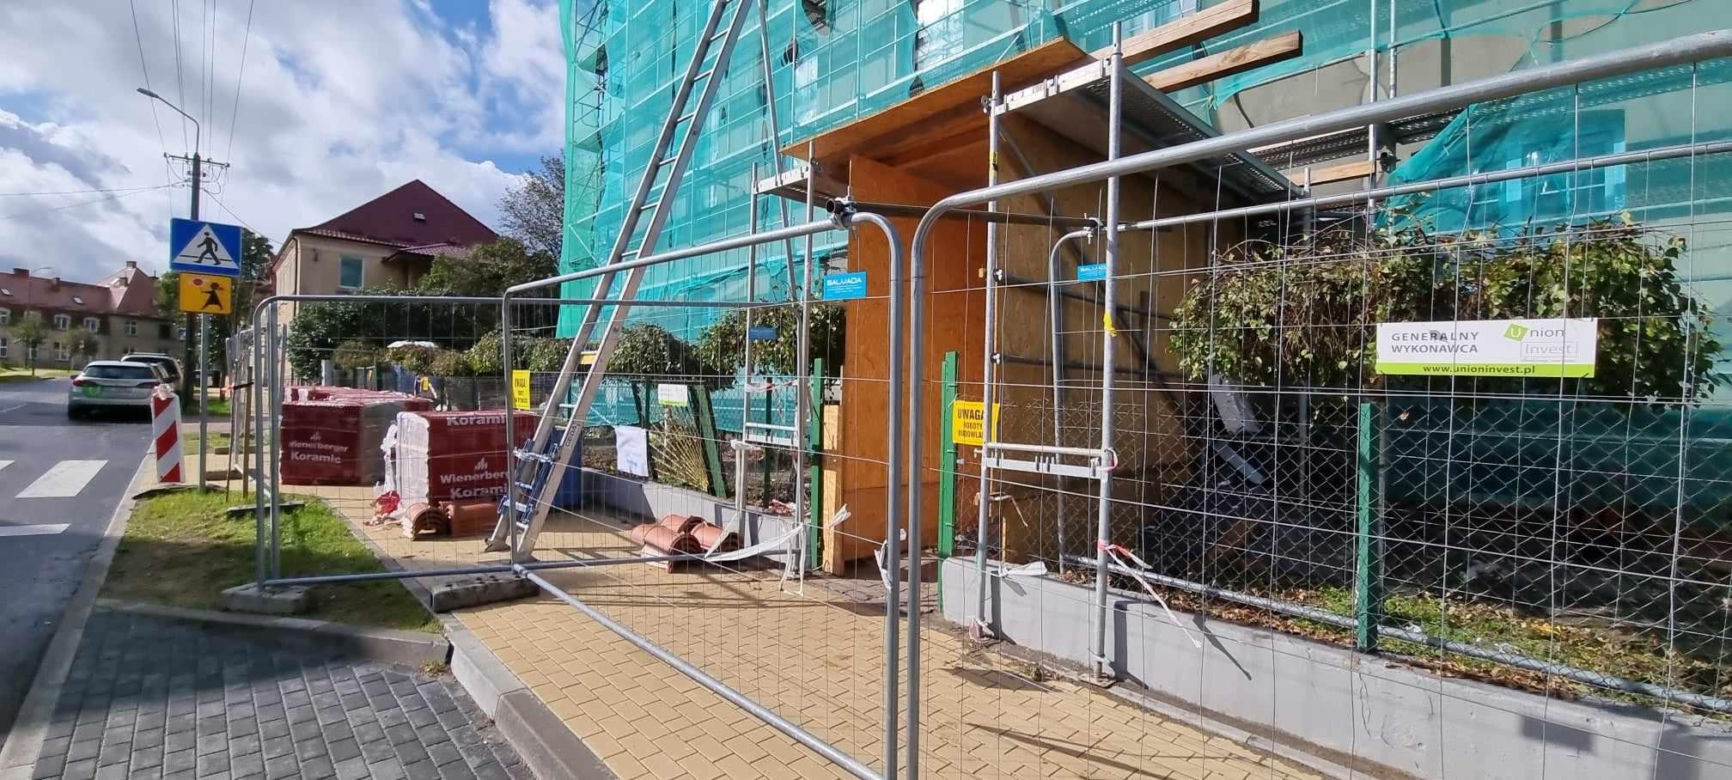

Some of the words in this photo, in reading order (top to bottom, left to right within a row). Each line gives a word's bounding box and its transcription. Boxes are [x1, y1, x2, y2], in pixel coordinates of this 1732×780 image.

[1391, 331, 1479, 341] GENERALNY
[1510, 327, 1565, 338] Union
[1391, 344, 1478, 353] WYKONAWCA
[1423, 365, 1536, 374] www.unioninvest.pl
[446, 415, 506, 426] Korami
[290, 451, 342, 464] Koramic
[440, 470, 508, 484] Wienerber
[450, 483, 507, 499] Korami
